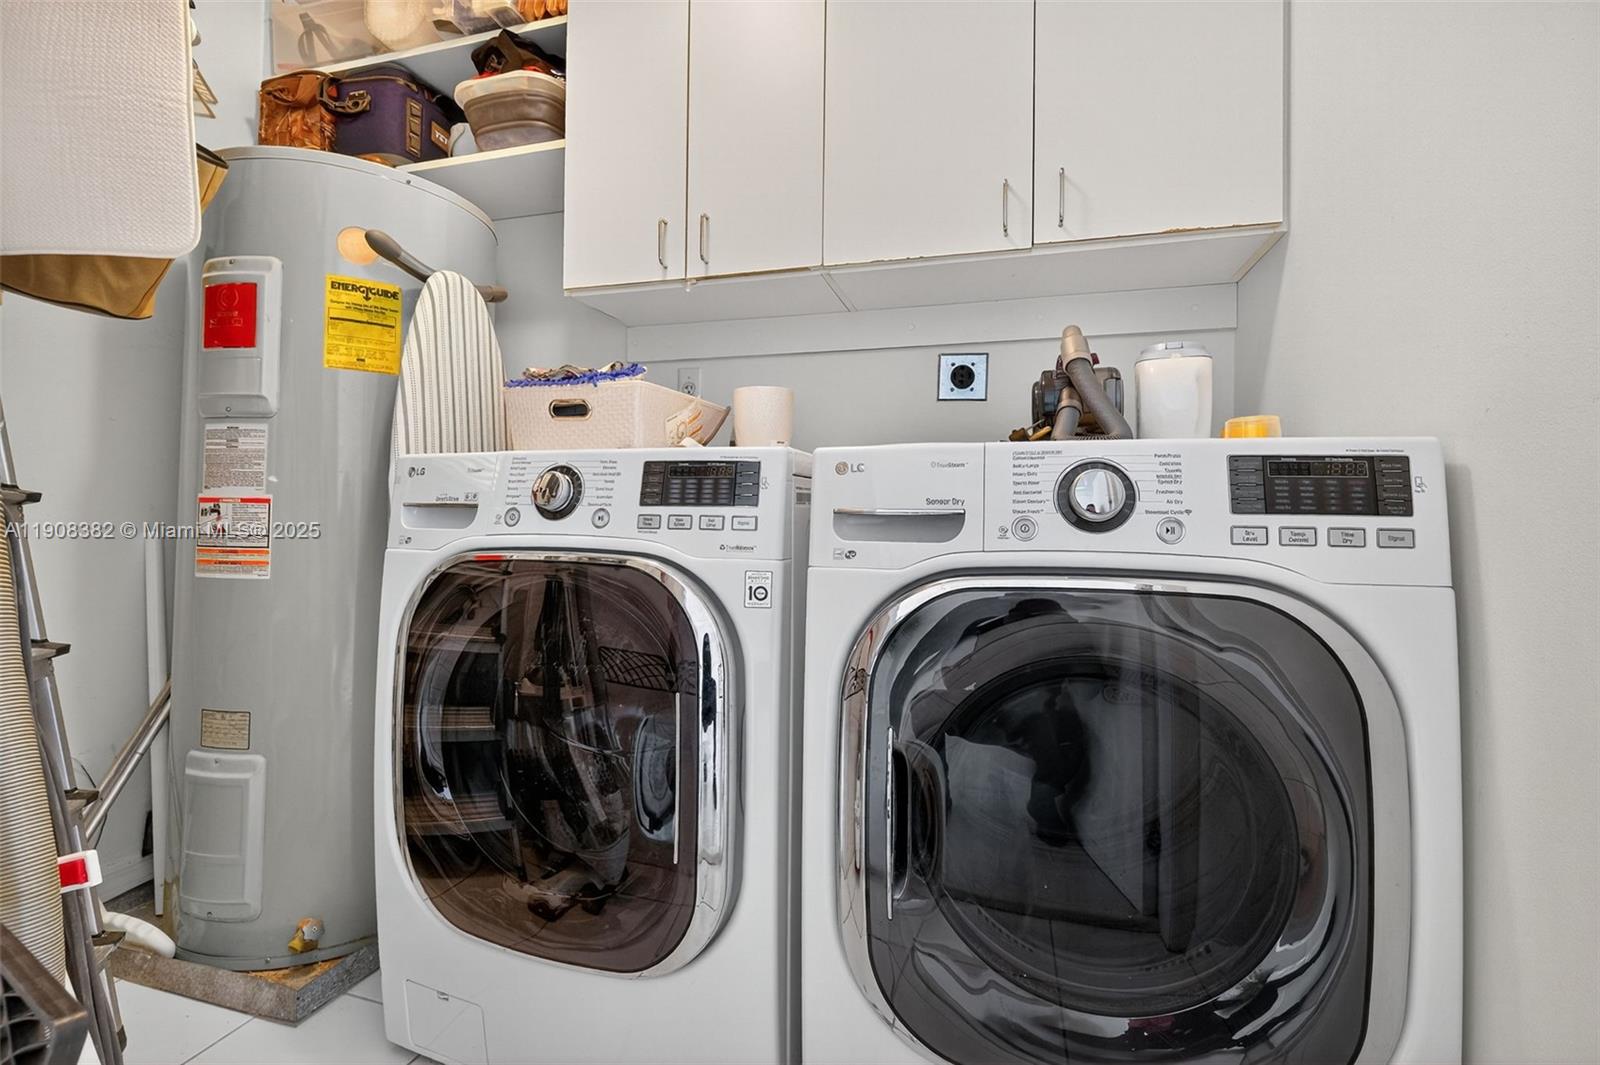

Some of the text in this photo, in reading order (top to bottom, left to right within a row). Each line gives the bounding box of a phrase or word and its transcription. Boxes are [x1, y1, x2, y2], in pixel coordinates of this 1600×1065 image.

[416, 467, 426, 476] LG
[850, 463, 865, 473] LG
[925, 497, 965, 507] Sensor Dry
[748, 585, 769, 602] 10
